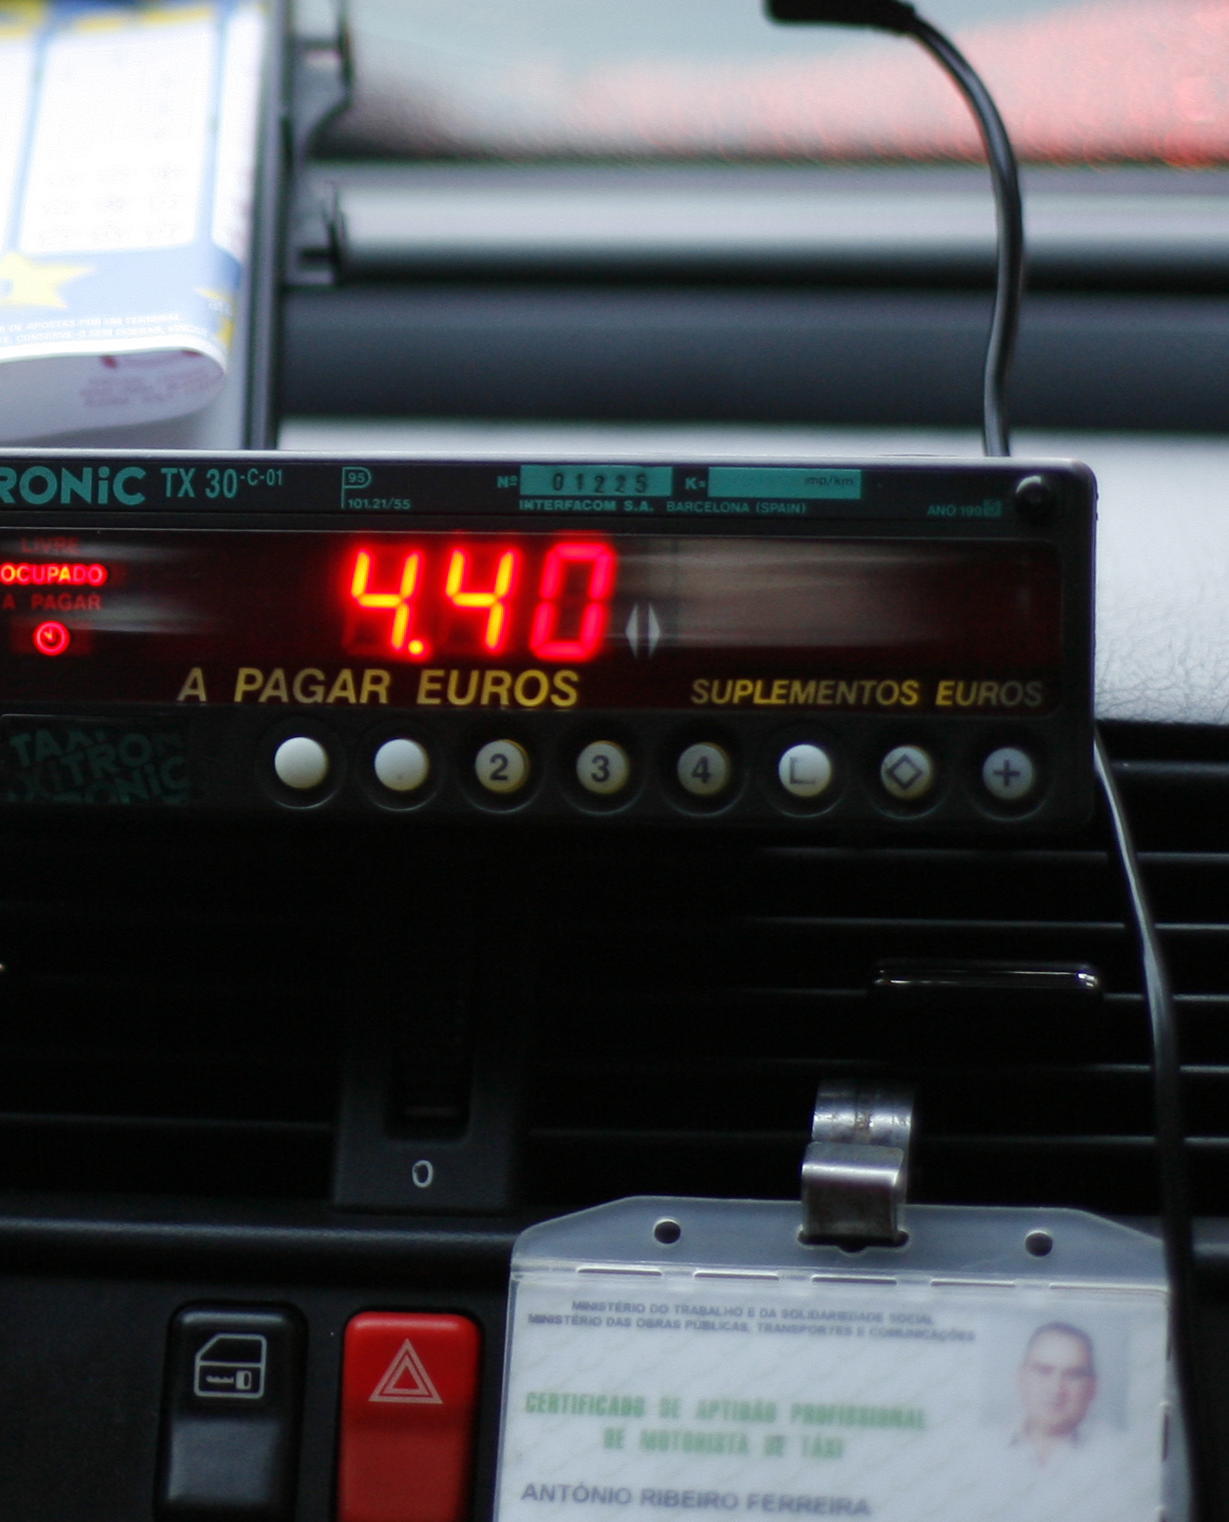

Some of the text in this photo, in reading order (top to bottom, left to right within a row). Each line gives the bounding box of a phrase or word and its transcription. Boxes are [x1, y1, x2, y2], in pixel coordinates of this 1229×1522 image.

[161, 467, 196, 498] TX
[348, 472, 366, 484] 95
[552, 470, 649, 494] 01225
[804, 475, 855, 489] imp/km
[348, 497, 411, 511] 101.21/55
[519, 499, 807, 515] INTERFACOM S.A. BARCELONA (SPAIN)
[20, 537, 81, 555] LIVRE
[1, 593, 103, 611] A PAGAR
[347, 540, 617, 663] 4.40
[177, 668, 580, 706] A PAGAR EUROS
[691, 678, 1044, 708] SUPLEMENTOS EUROS
[489, 752, 509, 782] 2
[590, 754, 610, 783] 3
[691, 756, 712, 784] 4
[572, 1300, 646, 1314] MINISTÉRIO
[650, 1303, 669, 1314] DO
[673, 1305, 743, 1317] TRABALHO
[748, 1307, 755, 1318] E
[759, 1308, 776, 1318] DA
[528, 1313, 602, 1327] MINISTÉRIO
[606, 1316, 631, 1328] DAS
[636, 1318, 681, 1330] OBRAS
[756, 1322, 852, 1337] TRANSPORTES
[856, 1326, 865, 1337] E
[524, 1391, 927, 1431] CERTIFICADO DE APTIDÃO PROFISSIONAL
[602, 1425, 625, 1451] DE
[639, 1428, 750, 1456] MOTORISTA
[763, 1434, 786, 1458] DE
[520, 1480, 874, 1517] ANTÓNIO RIBEIRO FERREIRA
